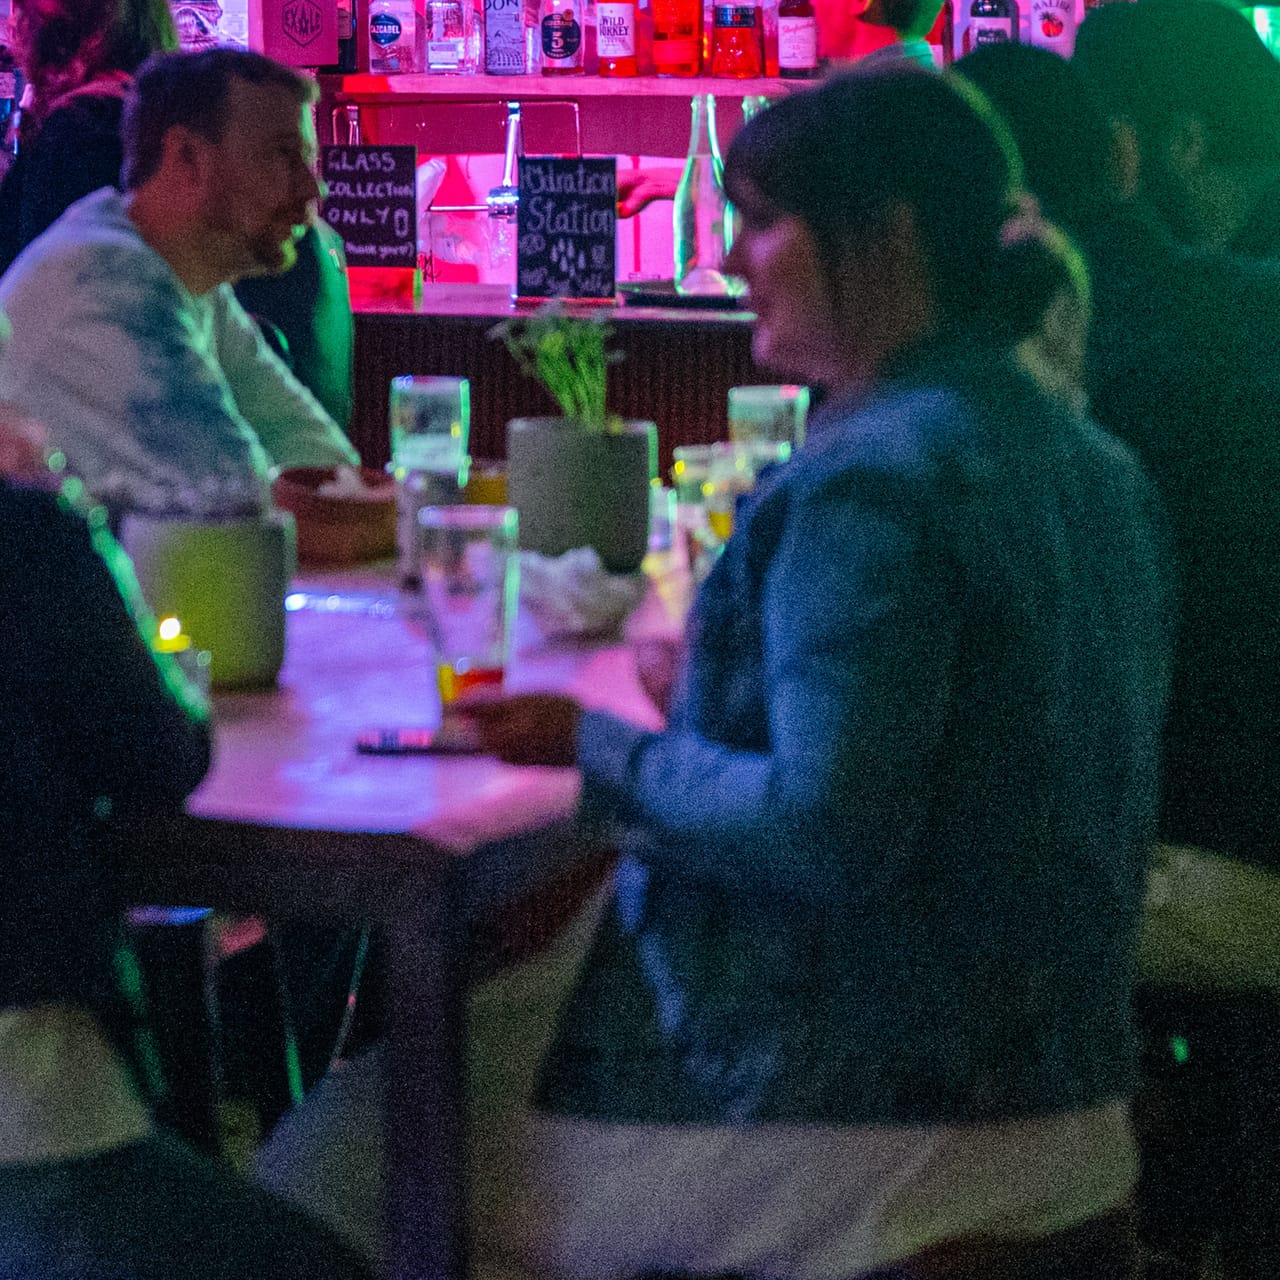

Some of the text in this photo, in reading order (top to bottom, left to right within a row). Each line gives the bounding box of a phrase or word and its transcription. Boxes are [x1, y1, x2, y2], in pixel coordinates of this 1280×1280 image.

[601, 16, 624, 27] WILD
[552, 32, 564, 48] 5
[328, 149, 396, 172] GLASS
[328, 208, 391, 225] ONLY
